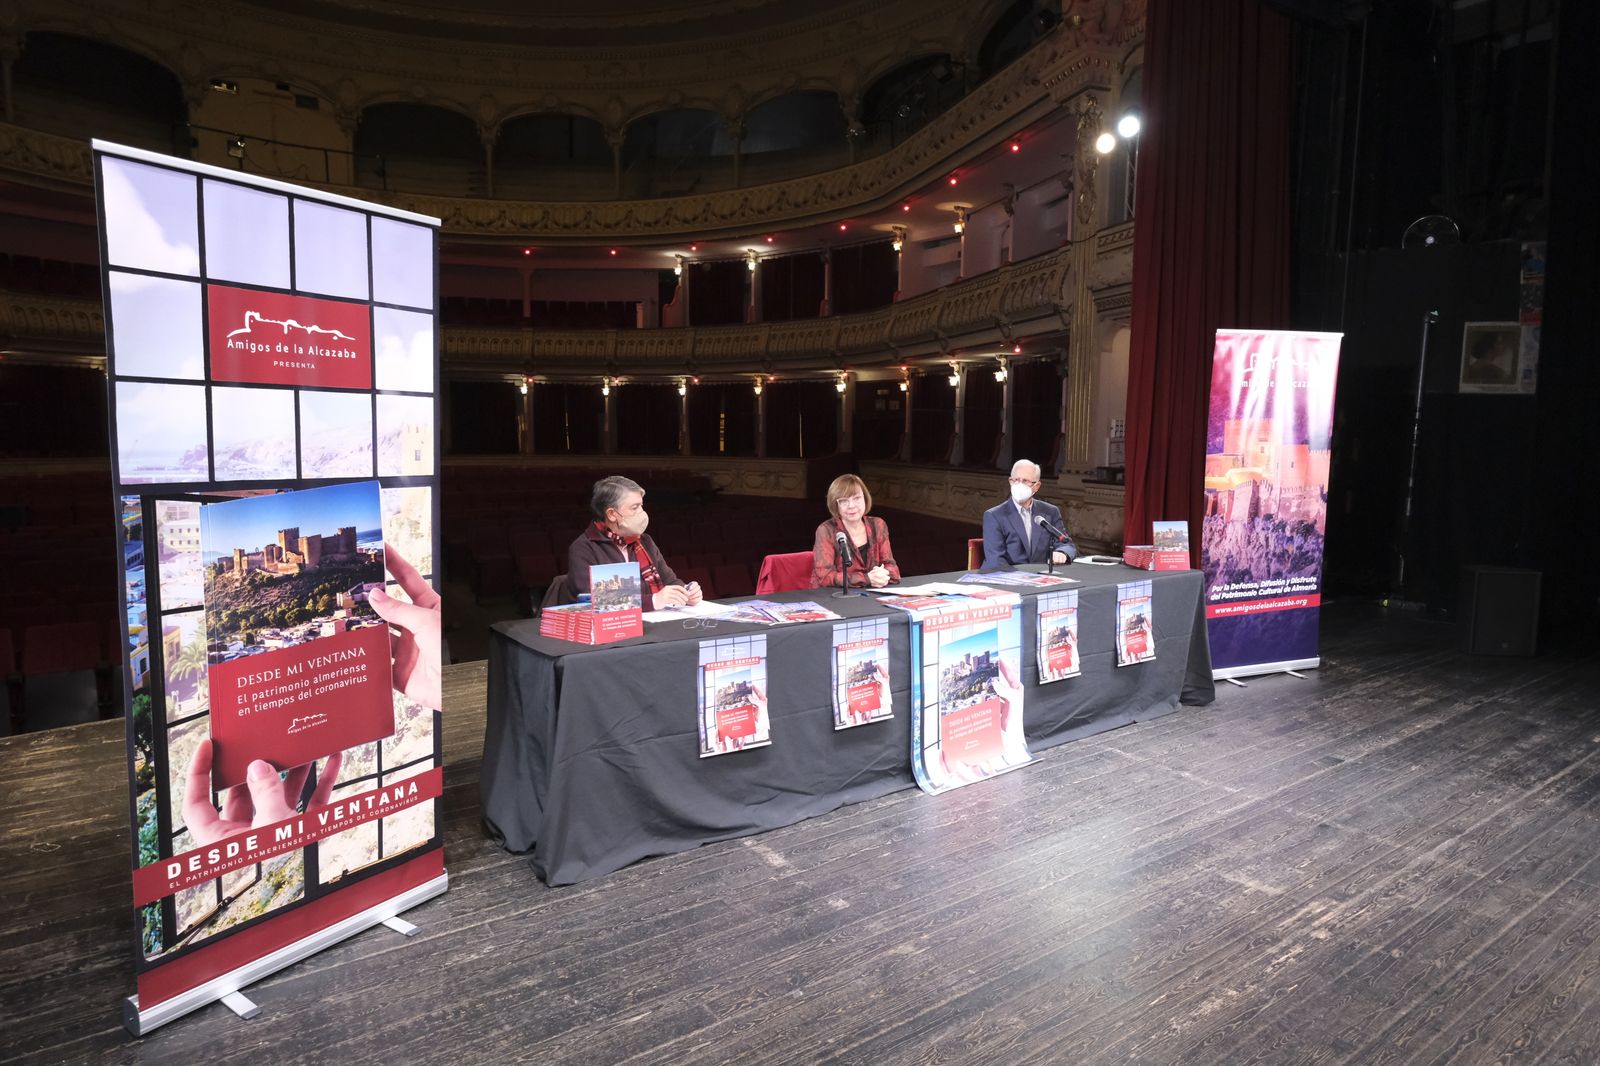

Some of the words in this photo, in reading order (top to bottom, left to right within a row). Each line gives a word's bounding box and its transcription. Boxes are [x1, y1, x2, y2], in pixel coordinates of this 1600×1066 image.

[227, 339, 271, 353] Amigos
[276, 342, 289, 353] de
[294, 344, 304, 354] la
[308, 346, 356, 359] Alcazaba
[273, 361, 315, 369] PRESENTA
[1221, 590, 1257, 599] Patrimonio
[1258, 586, 1283, 595] Cultural
[1230, 582, 1259, 590] Defensa,
[1290, 576, 1317, 584] Disfrute
[1215, 599, 1307, 614] www.amigosdelaalcazaba.org
[237, 668, 281, 688] DESDE
[287, 662, 303, 677] MI
[307, 647, 366, 669] VENTANA
[237, 694, 248, 705] El
[252, 680, 309, 702] patrimonio
[313, 663, 367, 684] almeriense
[238, 706, 250, 717] en
[254, 695, 295, 712] tiempos
[298, 689, 312, 700] del
[315, 674, 368, 695] coronavirus
[167, 835, 258, 880] DESDE
[275, 820, 304, 843] MI
[318, 781, 418, 826] VENTANA
[169, 879, 180, 889] EL
[186, 858, 243, 883] PATRIMONIO
[247, 837, 303, 860] ALMERIENSE
[306, 832, 317, 840] EN
[320, 818, 354, 834] TIEMPOS
[356, 813, 366, 821] DE
[369, 796, 418, 817] CORONAVIRUS
